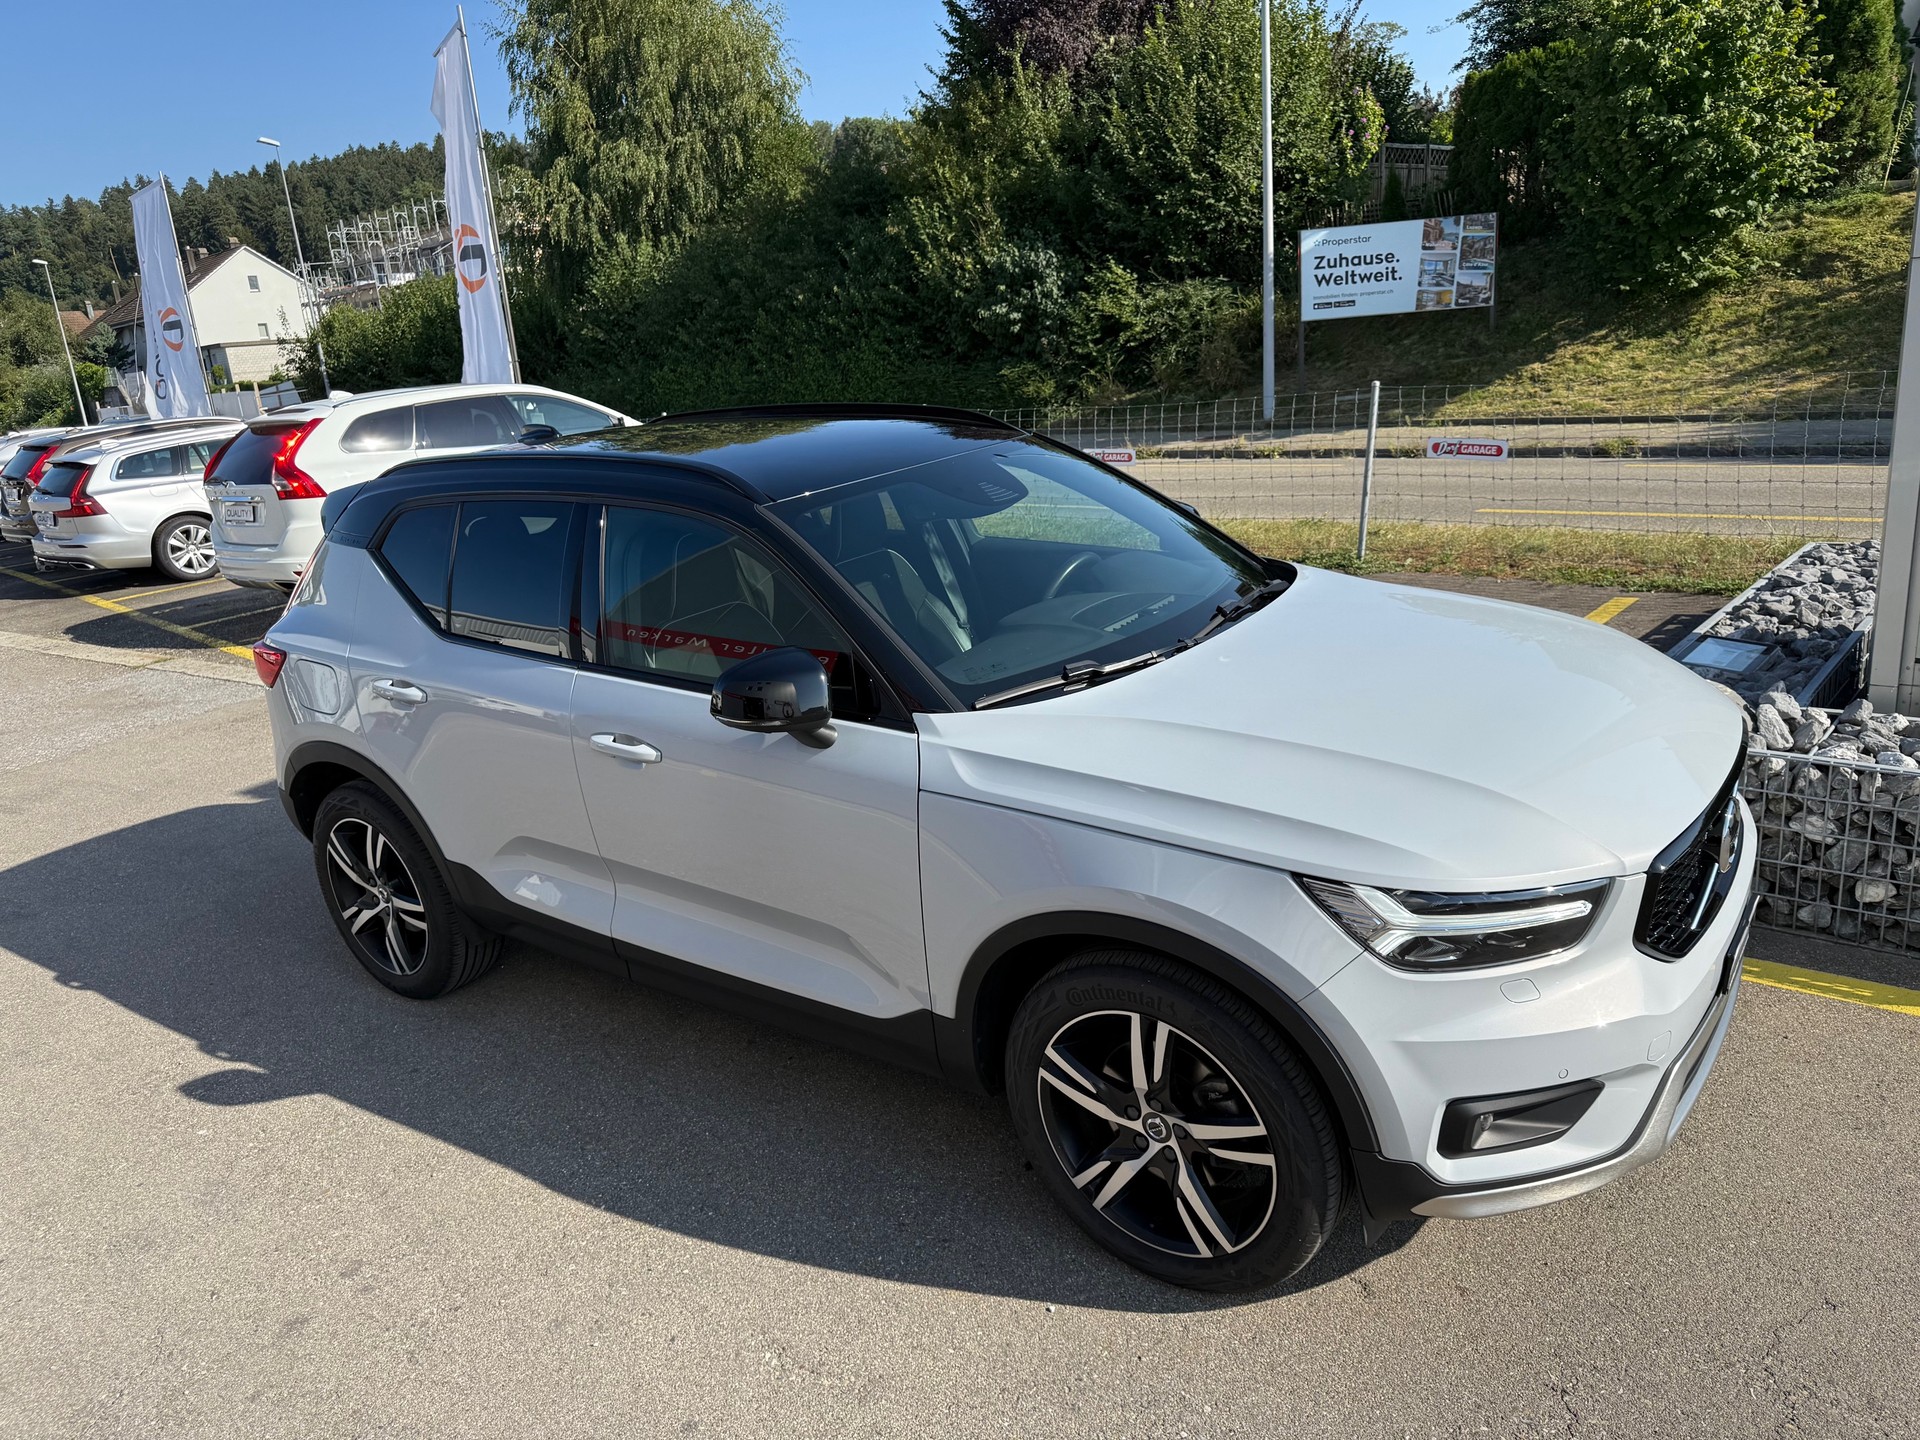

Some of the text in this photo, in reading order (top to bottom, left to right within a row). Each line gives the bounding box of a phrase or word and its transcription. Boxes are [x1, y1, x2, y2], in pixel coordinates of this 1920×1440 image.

[1322, 236, 1372, 247] Properstar
[1314, 253, 1400, 270] Zuhause.
[1314, 267, 1402, 287] Weltweit.
[1103, 453, 1129, 461] GARAGE
[1461, 445, 1497, 455] GARAGE
[1066, 985, 1162, 1011] Continental
